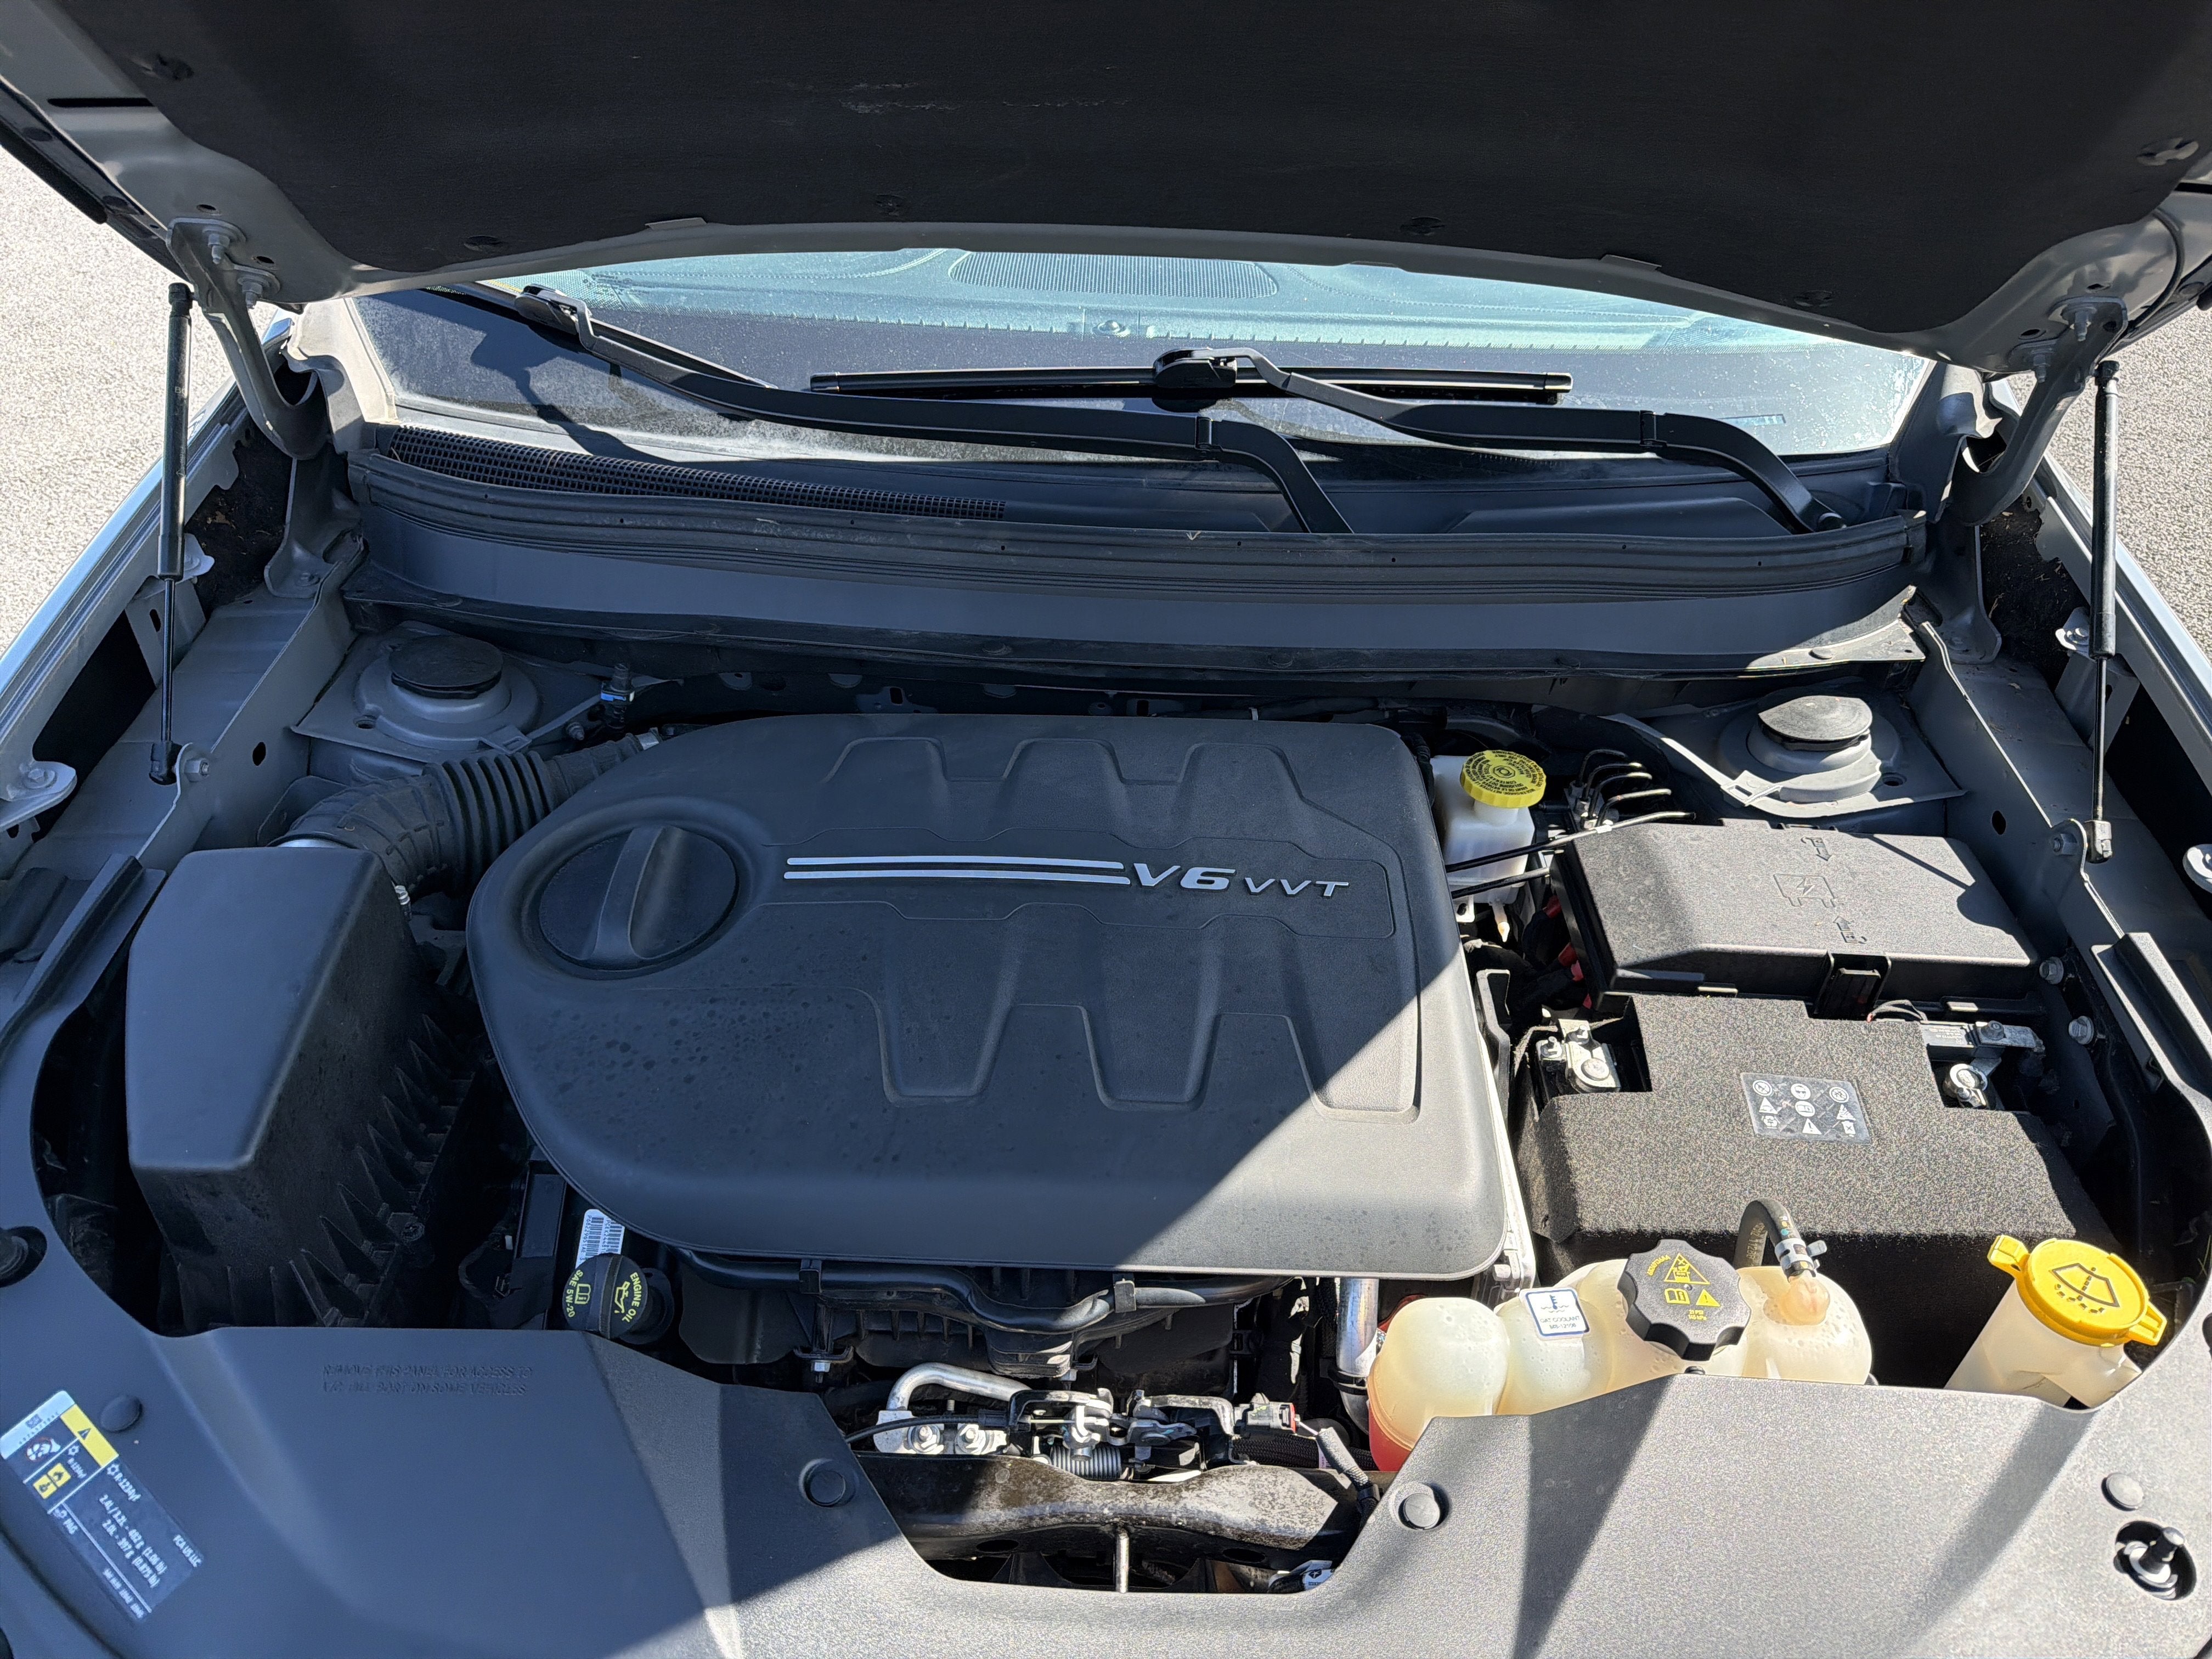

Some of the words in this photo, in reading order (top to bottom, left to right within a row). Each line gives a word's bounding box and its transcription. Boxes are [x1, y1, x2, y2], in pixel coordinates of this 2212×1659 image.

[1133, 862, 1237, 891] V6
[1244, 877, 1350, 898] VVT
[569, 1269, 583, 1287] SAE
[630, 1272, 642, 1307] ENGINE
[565, 1289, 575, 1318] 5W-20
[622, 1309, 637, 1323] OIL
[113, 1471, 142, 1503] R-1234yf
